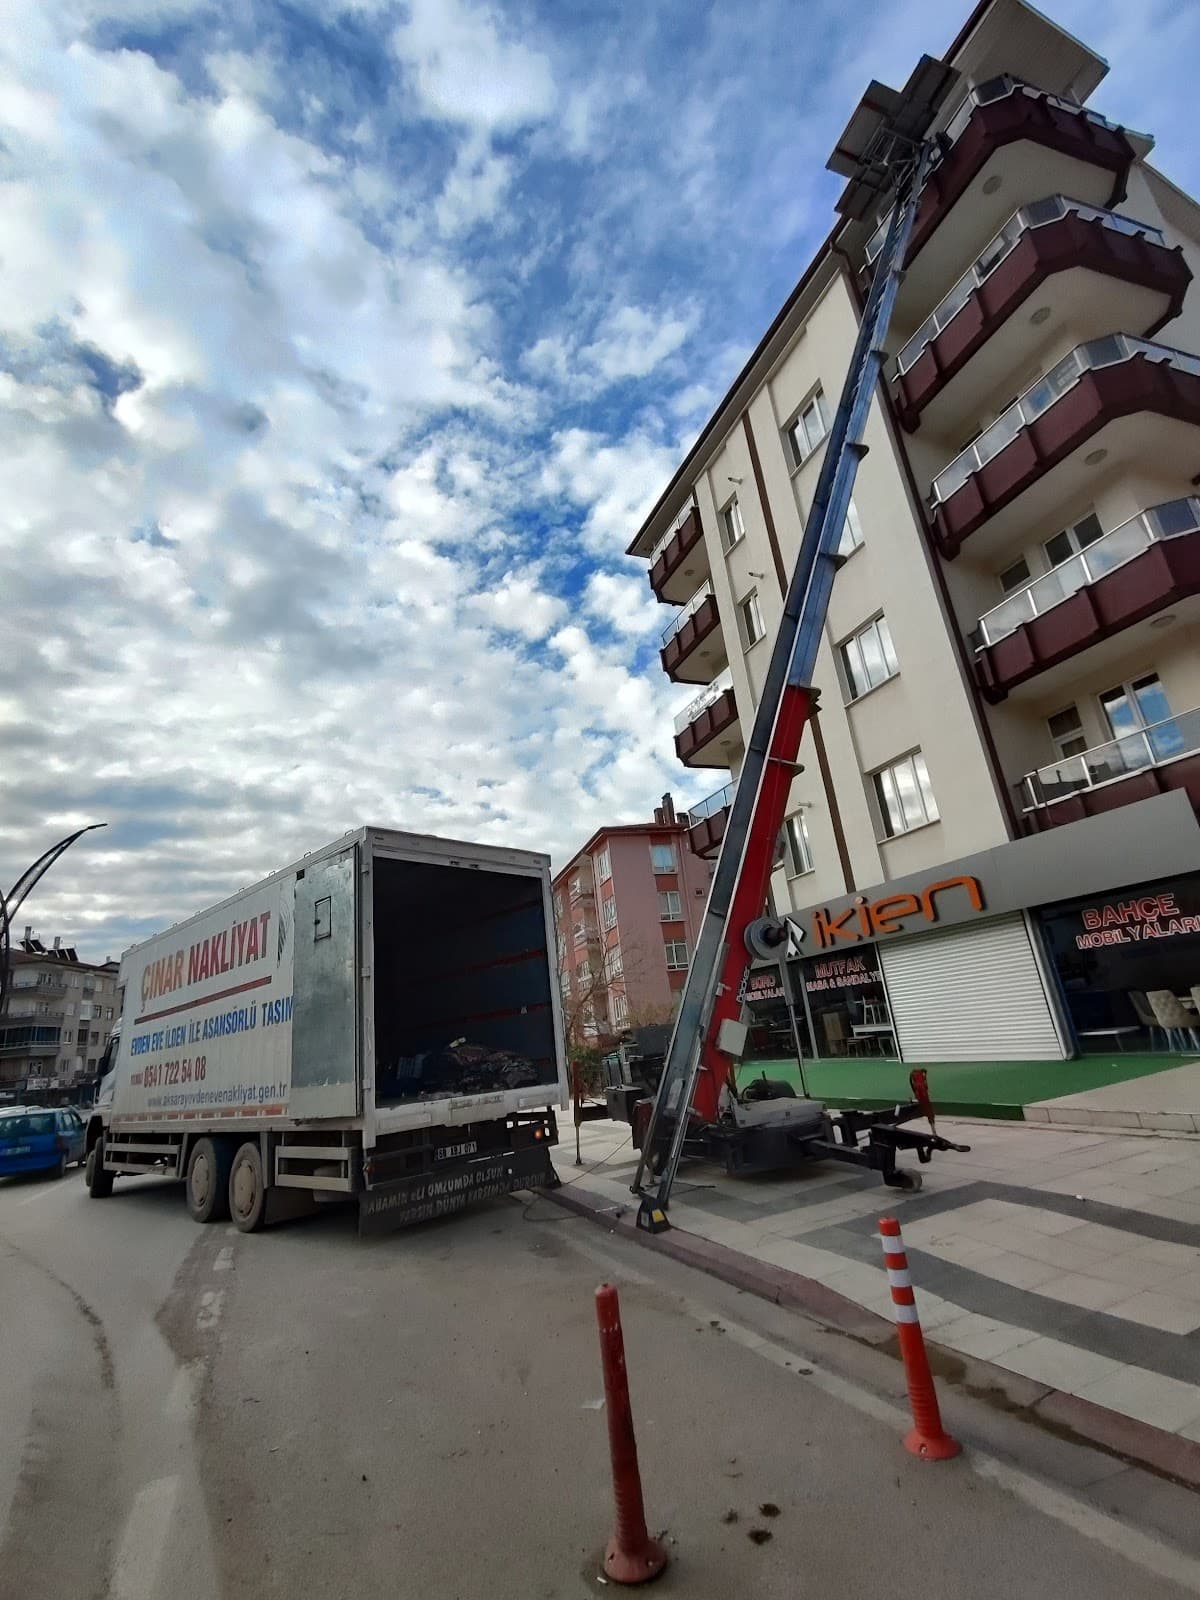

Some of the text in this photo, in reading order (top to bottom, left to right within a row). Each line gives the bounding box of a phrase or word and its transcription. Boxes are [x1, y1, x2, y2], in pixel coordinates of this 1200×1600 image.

[1081, 893, 1180, 930] BAHÇE
[187, 911, 272, 986] NAKLİYAT
[814, 955, 867, 979] MUTFAK
[151, 1030, 164, 1052] EVE
[164, 1060, 179, 1085] 722
[181, 1058, 193, 1083] 54
[195, 1056, 207, 1081] 08
